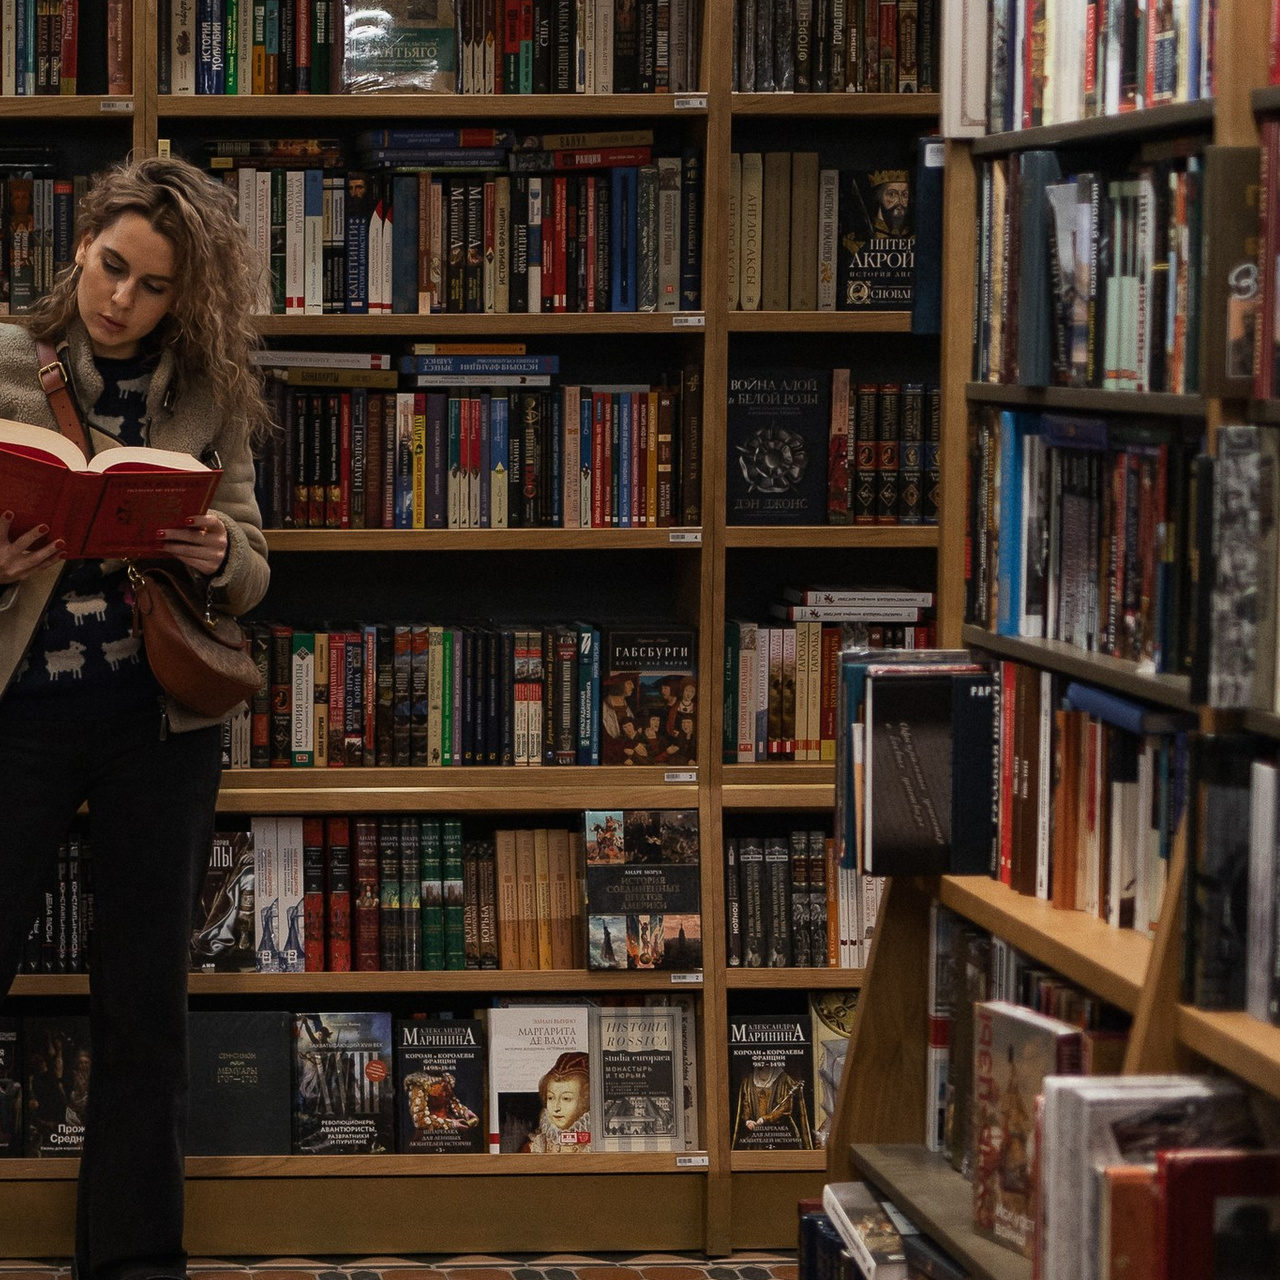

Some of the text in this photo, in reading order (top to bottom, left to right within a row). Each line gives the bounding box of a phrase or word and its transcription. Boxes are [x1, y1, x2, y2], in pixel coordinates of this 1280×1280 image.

[541, 19, 549, 47] США
[833, 19, 843, 44] ГОРОД
[202, 22, 211, 62] ИСТОРИЯ
[212, 22, 223, 70] КОЛУМБИИ
[295, 177, 303, 233] БРУНГИЛЬДА
[498, 207, 506, 285] ИСТОРИЯ ФРАНЦИИ
[519, 224, 527, 273] ФРАНЦИИ
[746, 193, 756, 287] АНГЛОСАКСЫ
[870, 238, 916, 250] ПИТЕР
[349, 225, 358, 298] КАПЕТИНГИ
[849, 249, 915, 268] АКРОЙ
[730, 378, 817, 391] ВОЙНА АЛОЙ
[738, 392, 781, 404] БЕЛОЙ
[784, 393, 818, 404] РОЗЫ
[354, 430, 363, 486] НАПОЛЕОН
[734, 499, 808, 509] ДЭН ДЖОНС
[615, 647, 688, 658] ГАБСБУРГИ
[798, 631, 806, 672] ГАРОЛЬД
[811, 631, 819, 672] ГАРОЛЬД
[295, 663, 303, 748] ИСТОРИЯ ЕВРОПЫ
[621, 902, 667, 910] АМЕРИКИ
[403, 1027, 476, 1046] МАРИНИНА
[518, 1027, 576, 1036] МАРГАРИТА
[606, 1022, 667, 1032] HISTORIA
[731, 1023, 805, 1042] МАРИНИНА
[530, 1036, 577, 1045] ДЕ ВАЛУА
[607, 1037, 667, 1046] ROSSICA
[605, 1054, 670, 1064] studia europaea
[217, 1067, 258, 1075] МЕМУАРЫ
